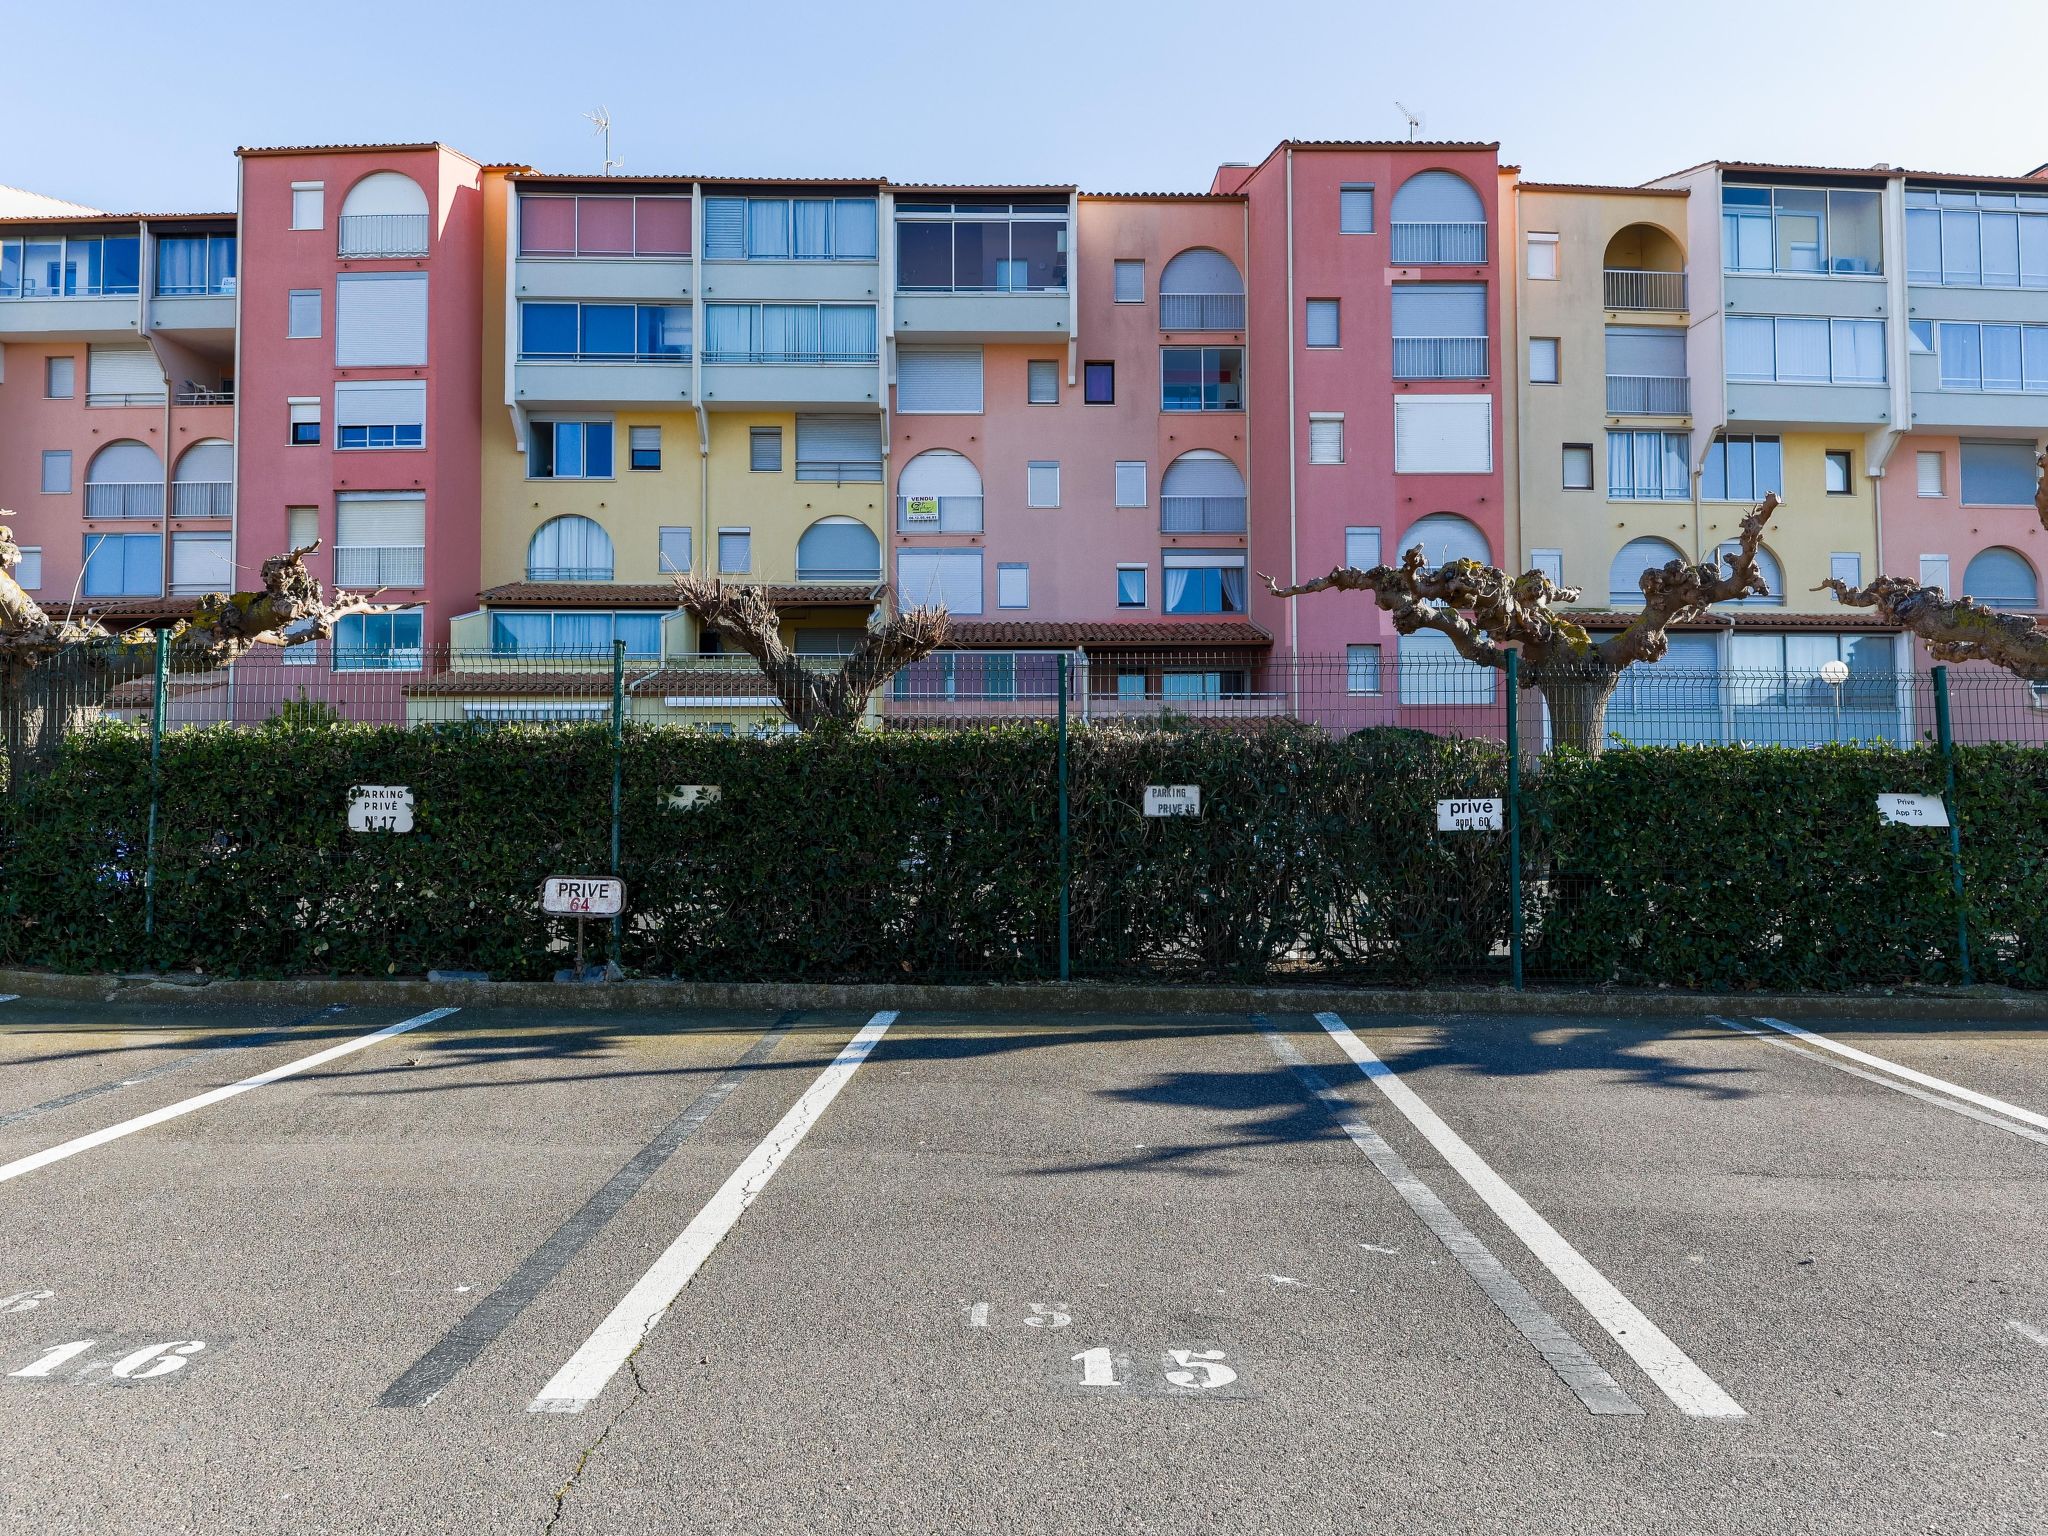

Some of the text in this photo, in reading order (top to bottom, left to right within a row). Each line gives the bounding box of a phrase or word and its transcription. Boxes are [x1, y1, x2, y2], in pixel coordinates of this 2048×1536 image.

[363, 790, 404, 799] ARKING
[1152, 788, 1186, 798] PARKING
[364, 800, 398, 810] PRIVÉ
[1158, 803, 1183, 814] PRIVE
[1450, 799, 1493, 817] privé
[1895, 809, 1923, 817] App 73
[381, 815, 397, 829] 17
[1478, 816, 1490, 827] 60
[558, 882, 610, 899] PRIVE
[570, 897, 590, 912] 64
[7, 1338, 206, 1379] 16
[1070, 1347, 1238, 1388] 15
